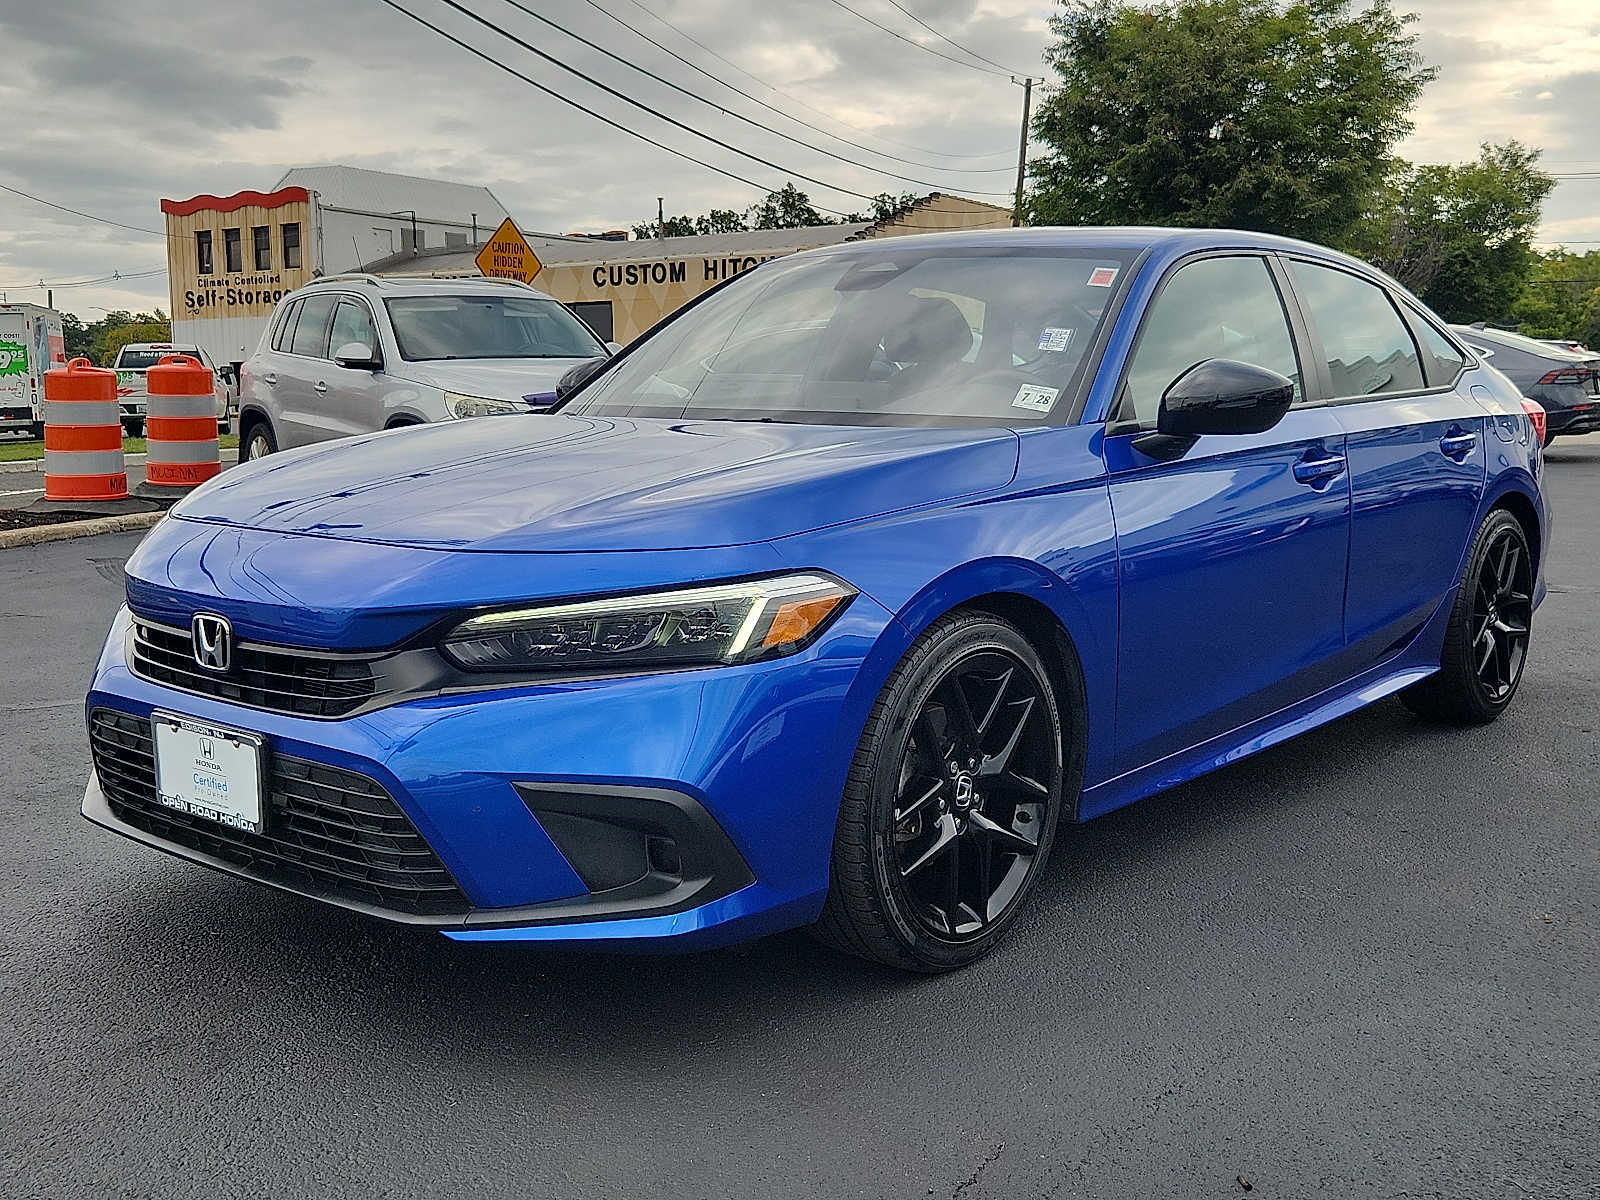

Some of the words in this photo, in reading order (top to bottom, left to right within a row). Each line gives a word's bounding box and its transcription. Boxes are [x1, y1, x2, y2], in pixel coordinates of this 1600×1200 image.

[492, 242, 525, 255] CAUTION
[493, 255, 523, 268] HIDDEN
[592, 261, 686, 287] CUSTOM
[197, 278, 229, 288] Climate
[234, 274, 280, 286] Controlled
[1036, 394, 1052, 405] 28
[213, 730, 225, 739] NJ
[195, 759, 222, 771] HONDA
[193, 773, 228, 792] Certified
[161, 795, 188, 812] OPEN
[190, 803, 218, 821] ROAD
[220, 812, 256, 833] HONDA
